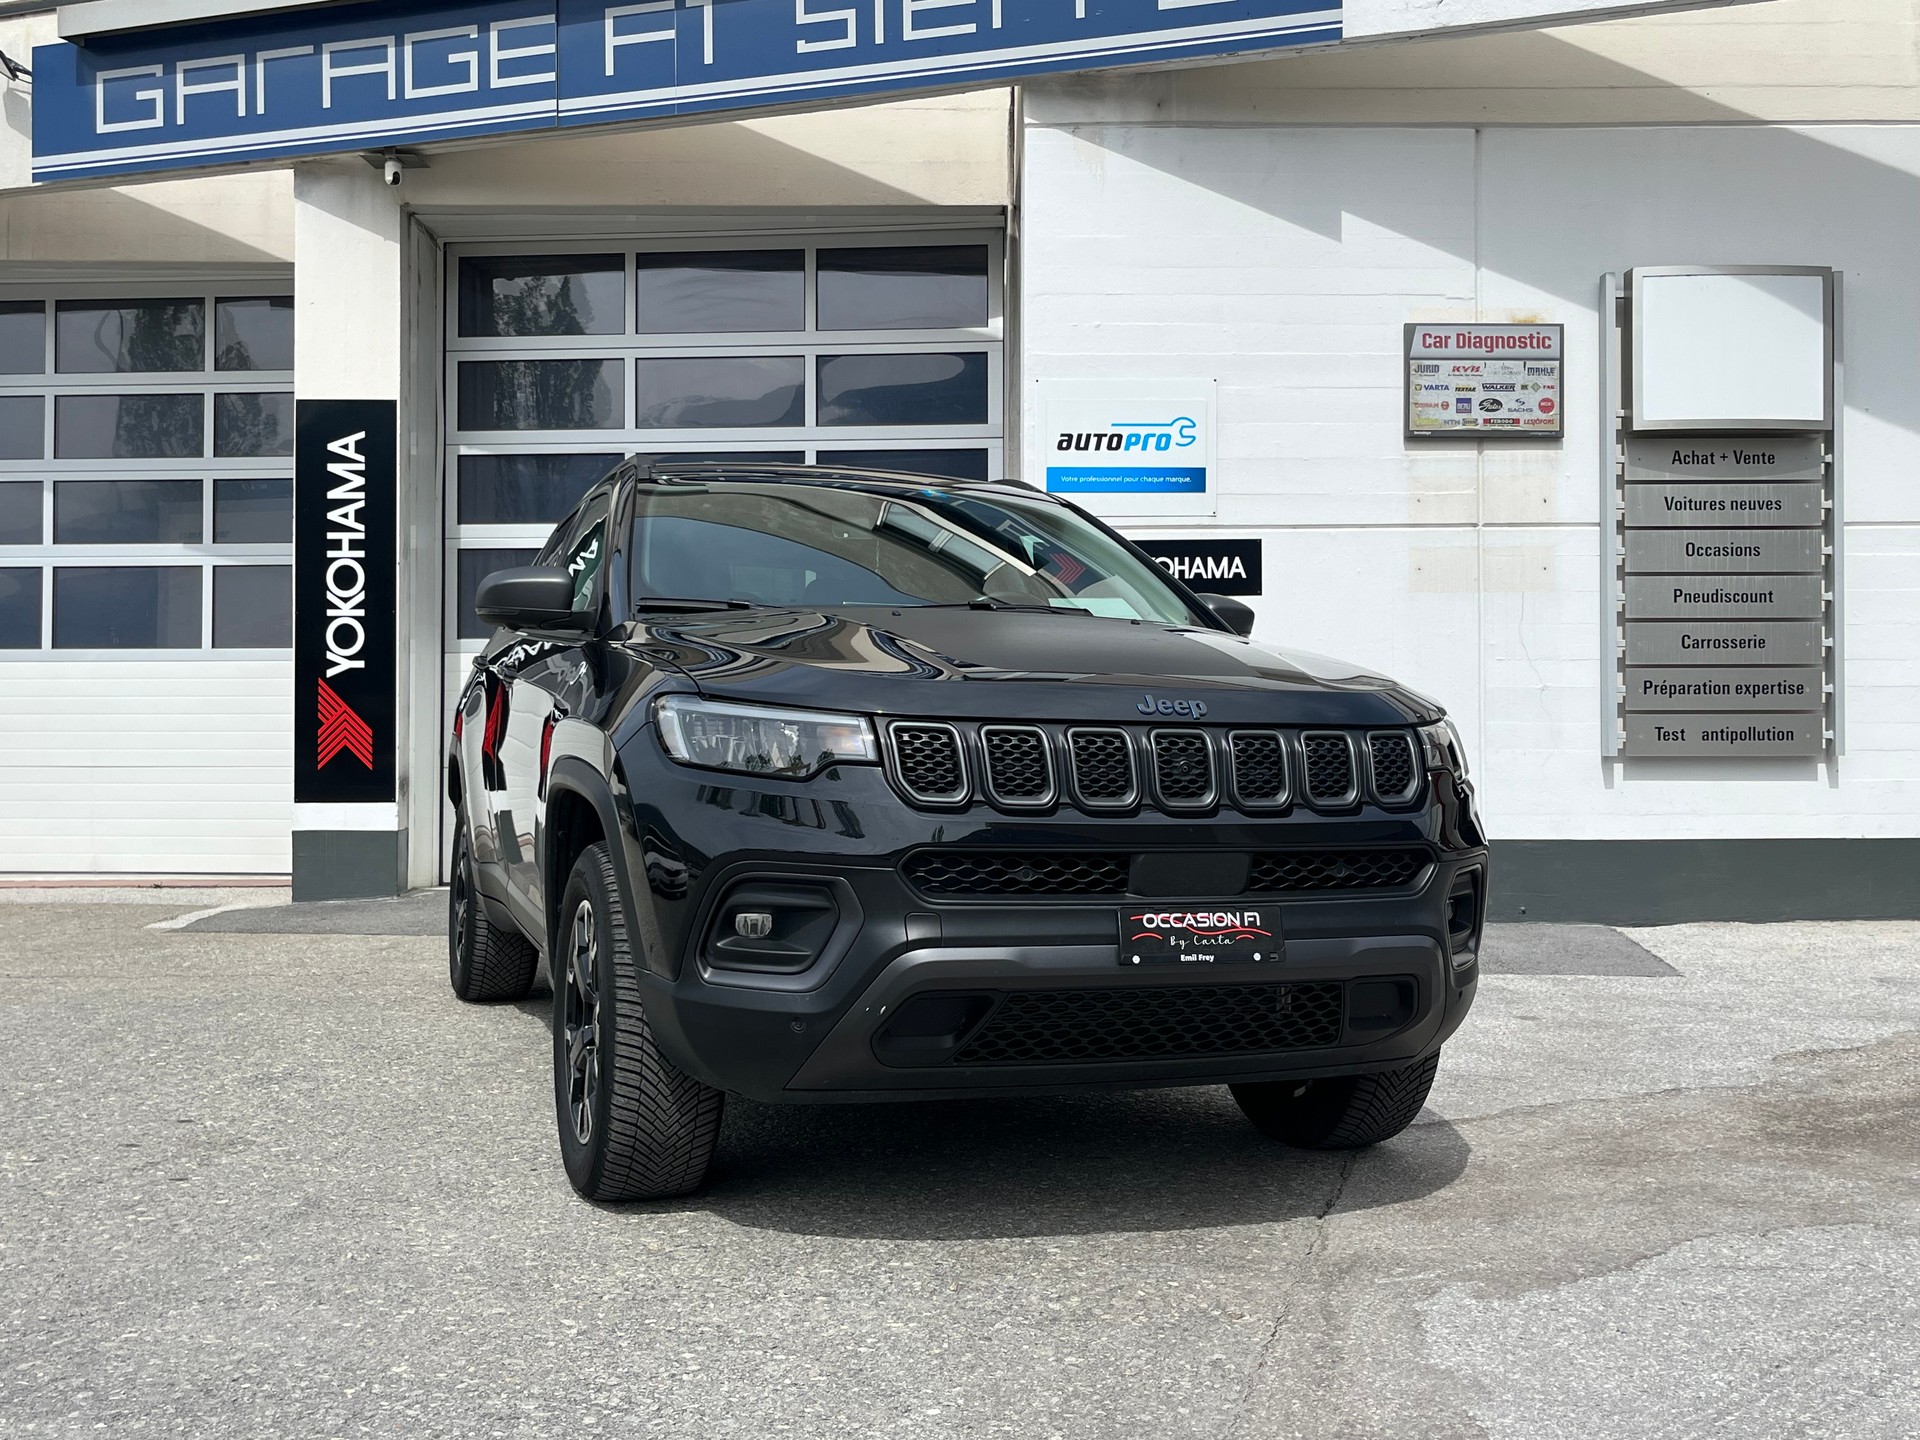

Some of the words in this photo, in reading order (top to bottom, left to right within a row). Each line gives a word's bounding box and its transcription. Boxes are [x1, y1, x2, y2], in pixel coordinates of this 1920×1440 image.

[96, 14, 557, 134] GARAGE
[1422, 333, 1451, 349] Car
[1456, 332, 1552, 353] Diagnostic
[1414, 364, 1440, 373] JURID
[1523, 418, 1555, 426] LESJÖFORS
[1671, 450, 1716, 465] Achat
[1733, 450, 1776, 465] Vente
[1079, 476, 1123, 484] professionnel
[1140, 476, 1165, 484] chaque
[1664, 496, 1726, 511] Voitures
[1730, 499, 1782, 511] neuves
[326, 431, 366, 678] YOKOHAMA
[1685, 542, 1761, 557] Occasions
[1673, 588, 1774, 603] Pneudiscount
[1681, 634, 1766, 649] Carrosserie
[1643, 680, 1730, 698] Préparation
[1735, 680, 1805, 698] expertise
[1136, 695, 1208, 720] Jeep
[1654, 727, 1686, 742] Test
[1701, 727, 1794, 744] antipollution
[1142, 912, 1240, 928] OCCASION
[1193, 935, 1235, 945] Carta
[1180, 954, 1197, 962] Emil
[1198, 954, 1214, 962] Frey
